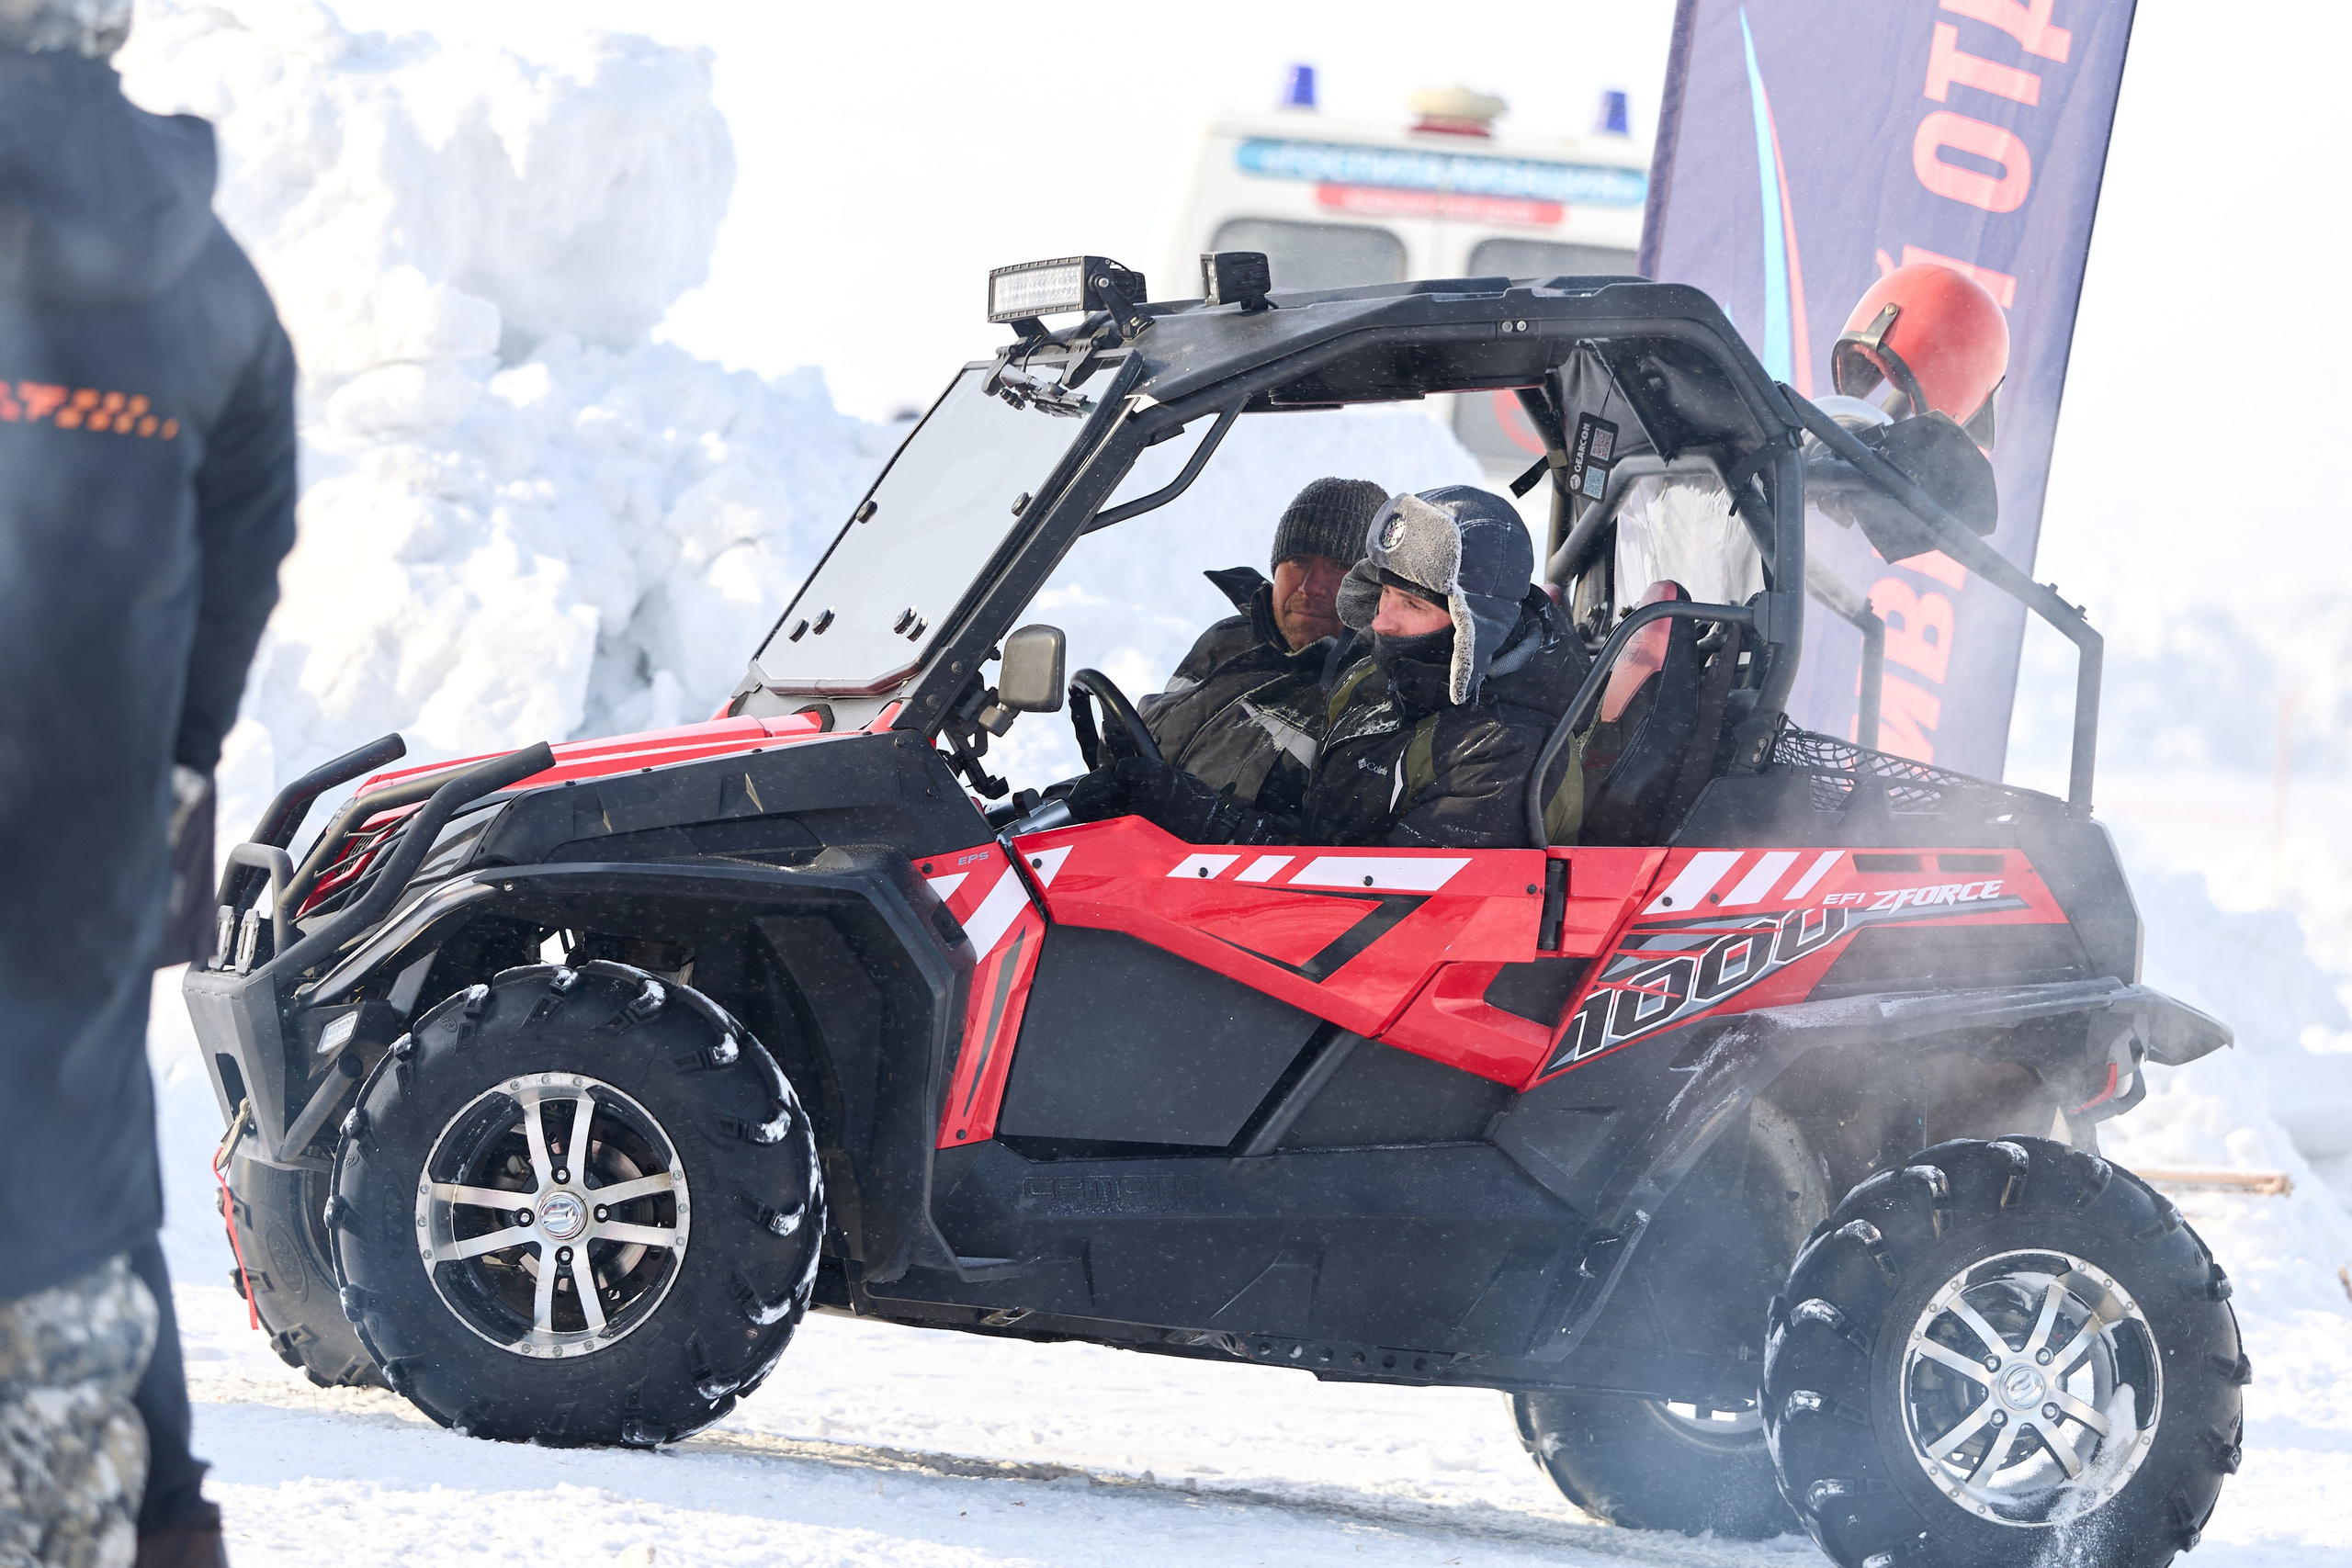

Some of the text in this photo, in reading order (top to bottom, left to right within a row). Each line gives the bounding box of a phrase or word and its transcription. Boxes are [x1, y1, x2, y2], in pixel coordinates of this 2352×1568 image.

[1574, 423, 1591, 473] GEARCON
[958, 851, 989, 866] EPS
[1822, 879, 2005, 916] EFI ZFORCE
[1573, 907, 1851, 1063] 1000
[1022, 1174, 1204, 1200] CFMOTO
